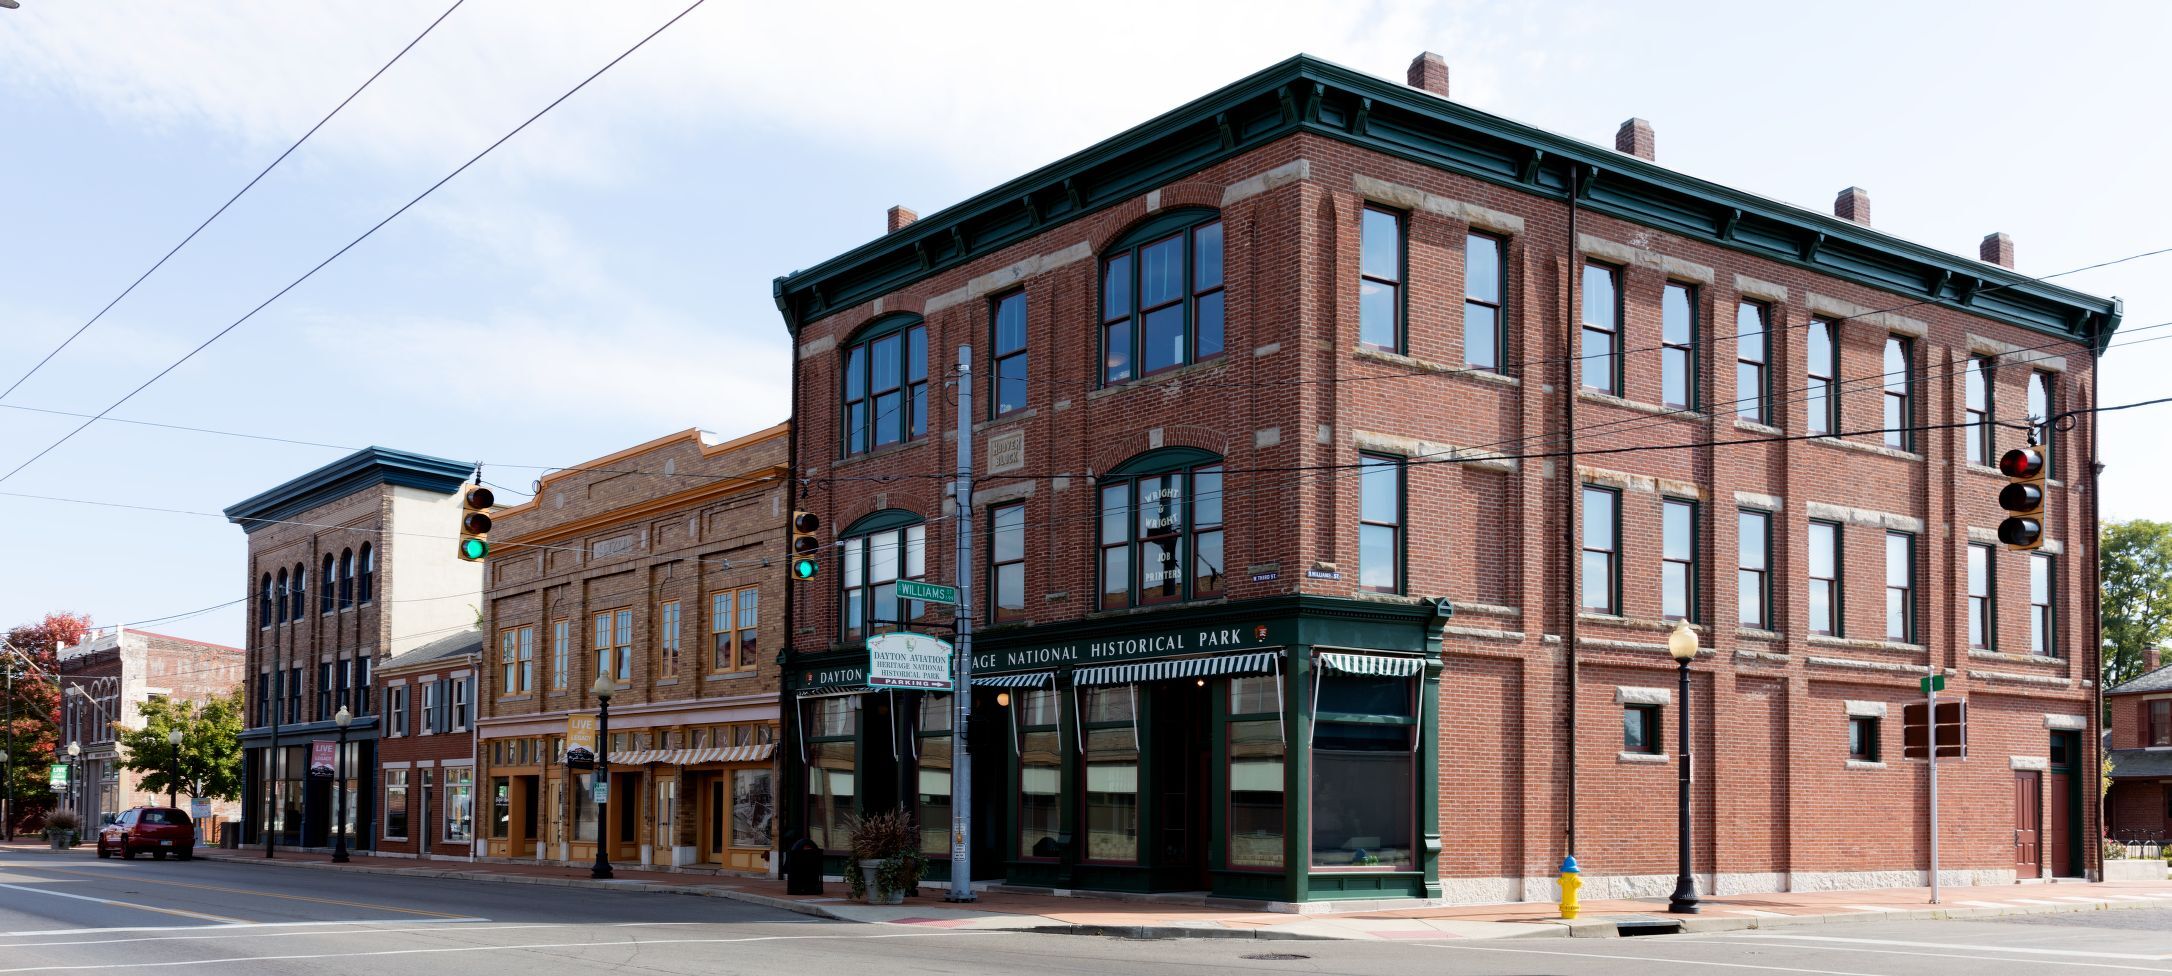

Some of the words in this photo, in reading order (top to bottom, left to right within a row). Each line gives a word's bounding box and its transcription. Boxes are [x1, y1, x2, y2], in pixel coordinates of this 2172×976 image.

[994, 451, 1018, 467] BLOCK
[1145, 488, 1179, 503] WRIGHT
[1145, 513, 1177, 529] WRIGHT
[1158, 552, 1171, 562] JOB
[1145, 569, 1182, 582] PRINTERS
[902, 583, 945, 600] WILLIAMS
[820, 669, 862, 684] DAYTON
[1008, 645, 1078, 666] NATIONAL
[1092, 634, 1184, 658] HISTORICAL
[1200, 628, 1241, 647] PARK
[874, 652, 906, 660] DAYTON
[909, 654, 946, 664] AVIATION
[877, 661, 910, 670] HERITAGE
[913, 663, 945, 672] NATIONAL
[881, 670, 920, 678] HISTORICAL
[923, 672, 940, 680] PARK
[885, 679, 929, 687] PARKING
[572, 720, 592, 730] LIVE
